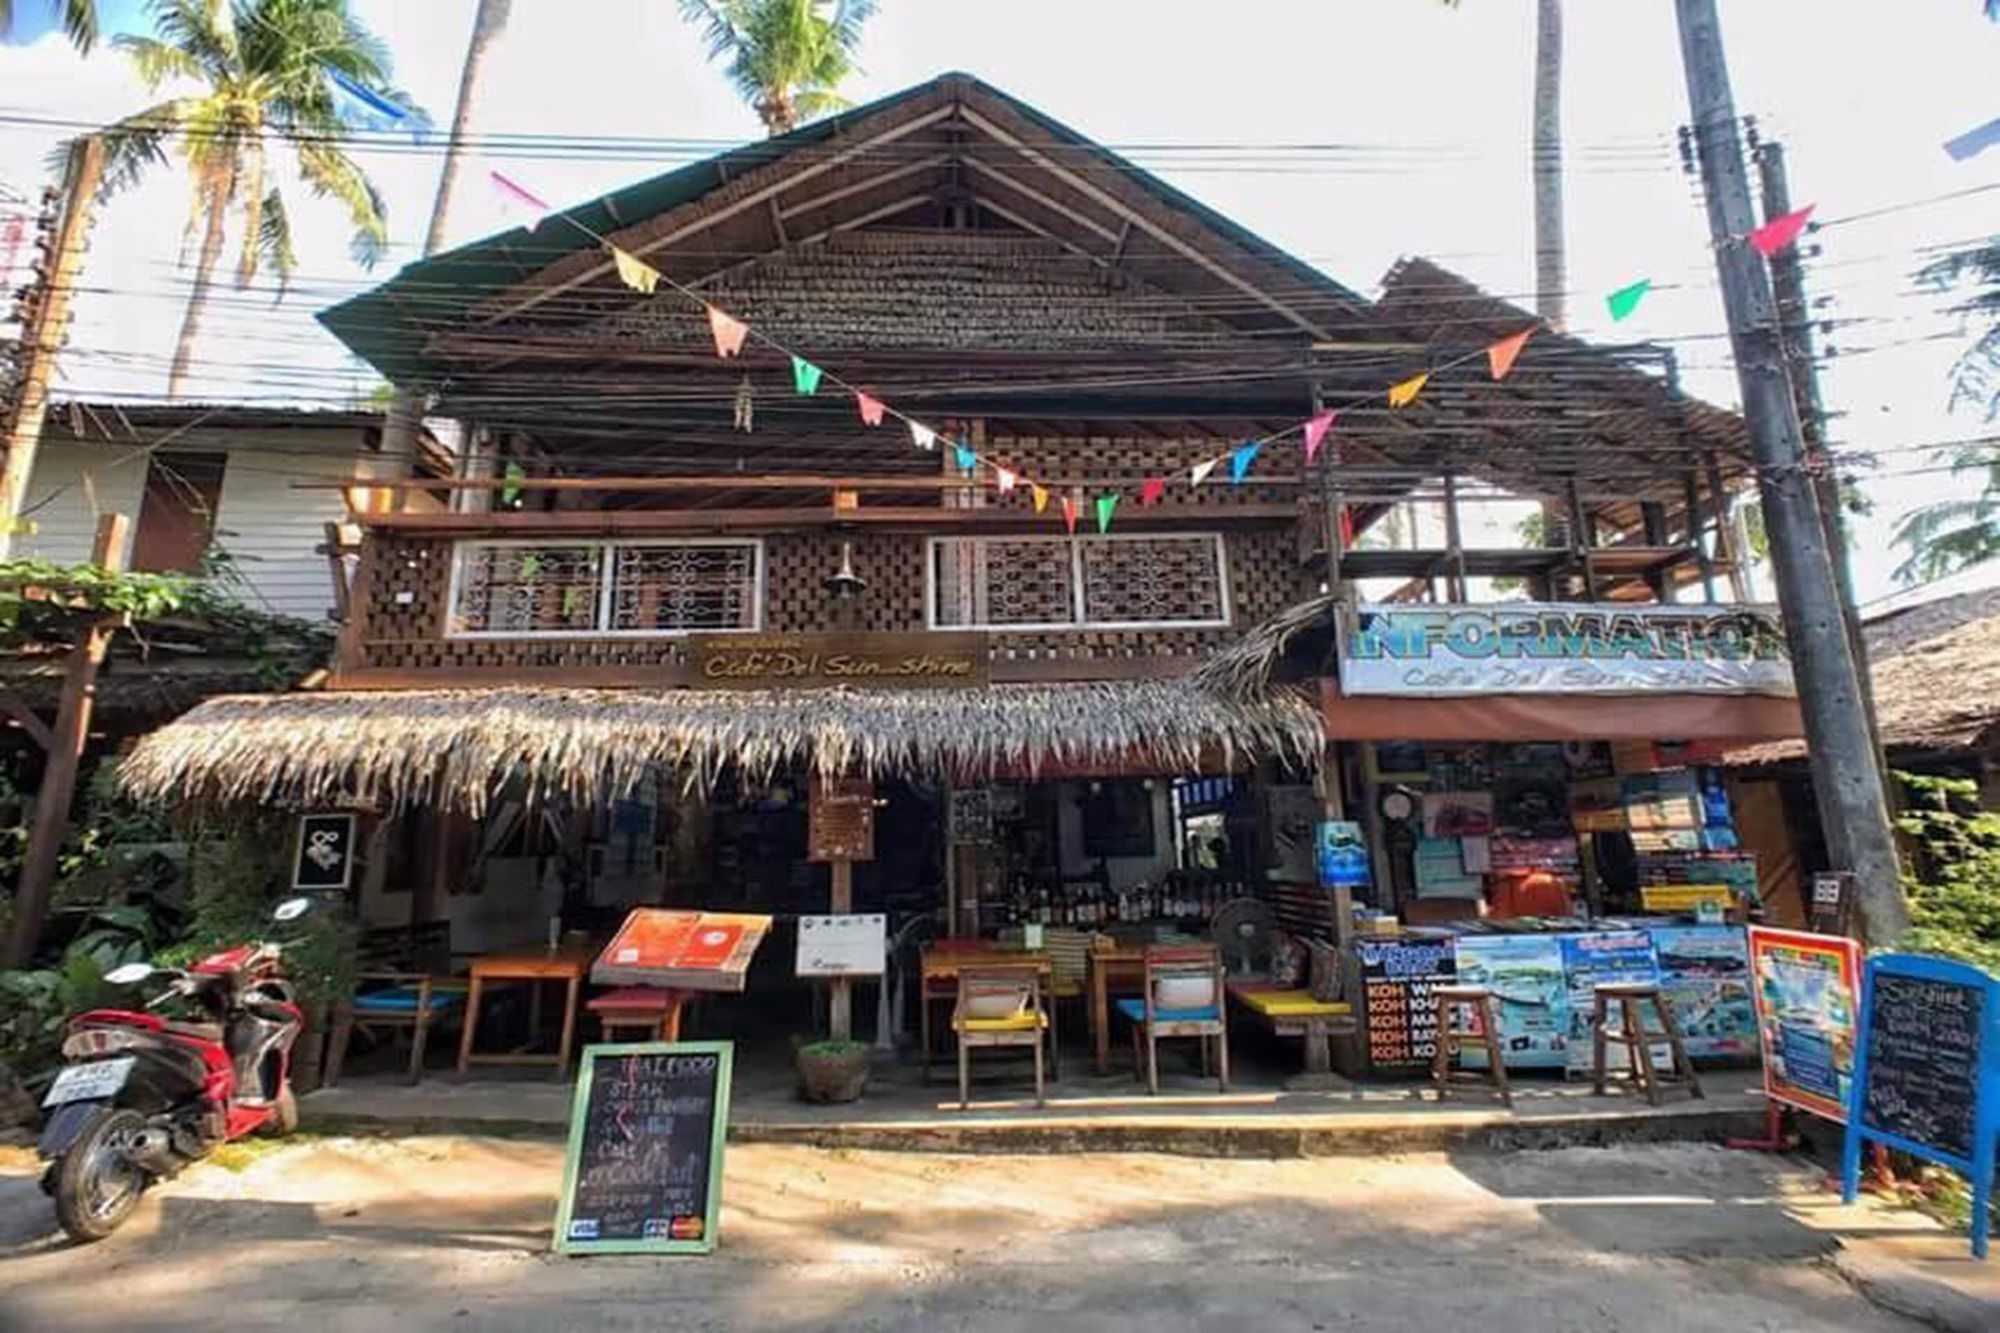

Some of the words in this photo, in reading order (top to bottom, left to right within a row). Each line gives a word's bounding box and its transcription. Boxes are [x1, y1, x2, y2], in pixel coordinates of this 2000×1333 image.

[1368, 984, 1405, 998] KOH
[1369, 999, 1406, 1013] KOH
[1370, 1014, 1407, 1028] KOH
[1371, 1029, 1408, 1043] KOH
[1372, 1044, 1409, 1058] KOH
